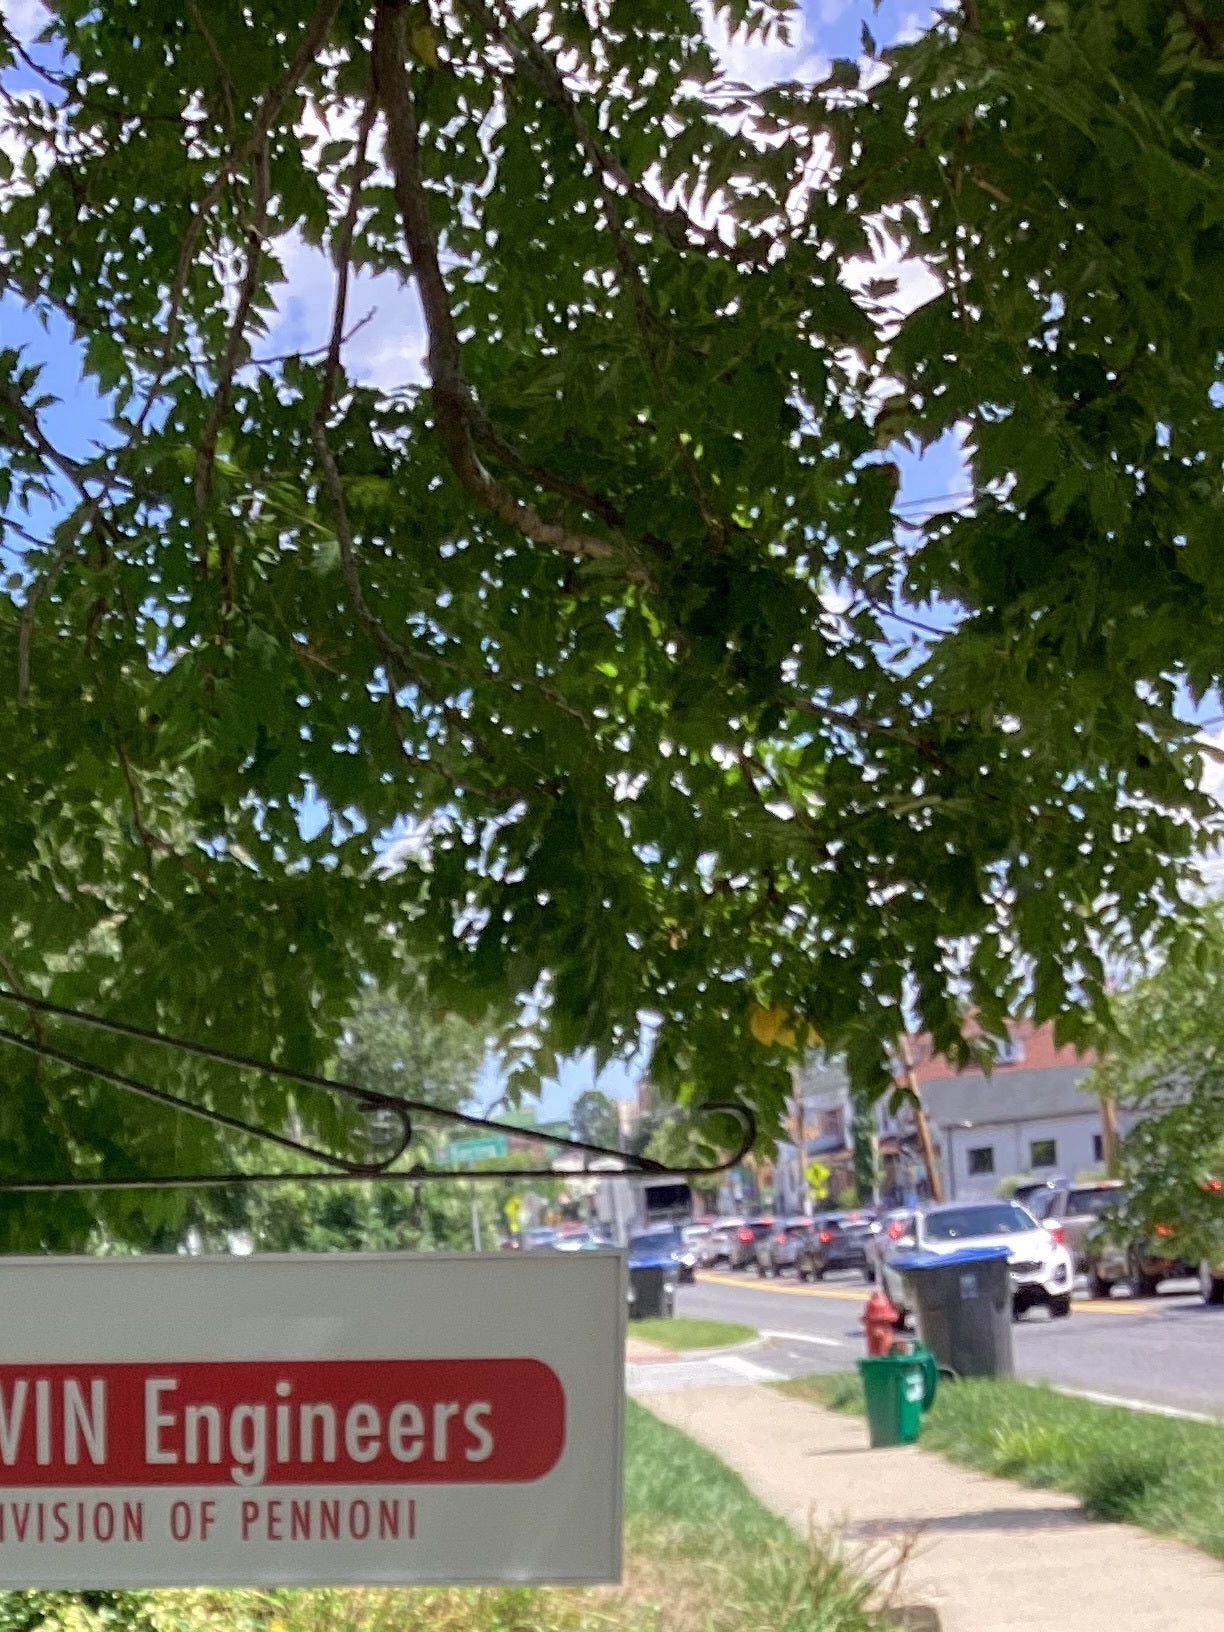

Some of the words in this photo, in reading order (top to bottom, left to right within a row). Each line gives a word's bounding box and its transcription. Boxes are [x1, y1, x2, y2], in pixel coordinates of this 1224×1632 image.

[145, 1378, 494, 1485] Engineers
[170, 1502, 217, 1541] OF
[241, 1500, 418, 1541] PENNONI
